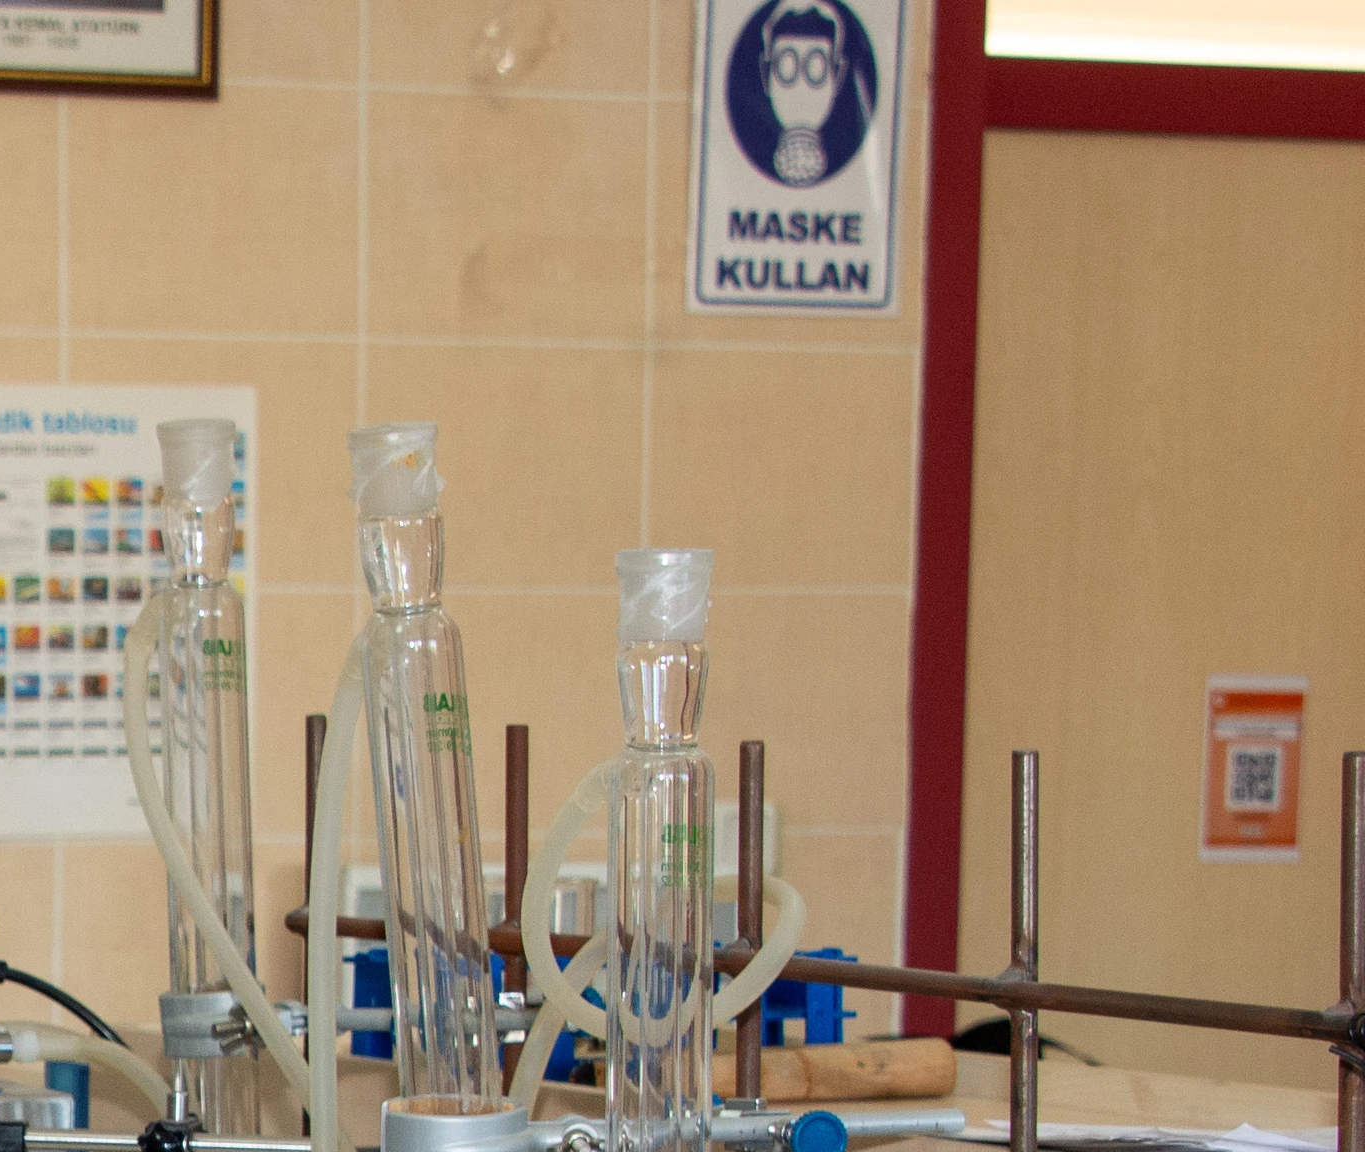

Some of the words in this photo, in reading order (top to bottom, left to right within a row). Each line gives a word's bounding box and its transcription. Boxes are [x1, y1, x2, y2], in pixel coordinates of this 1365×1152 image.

[728, 210, 864, 246] MASKE
[716, 257, 871, 295] KULLAN
[43, 412, 138, 435] tablosu
